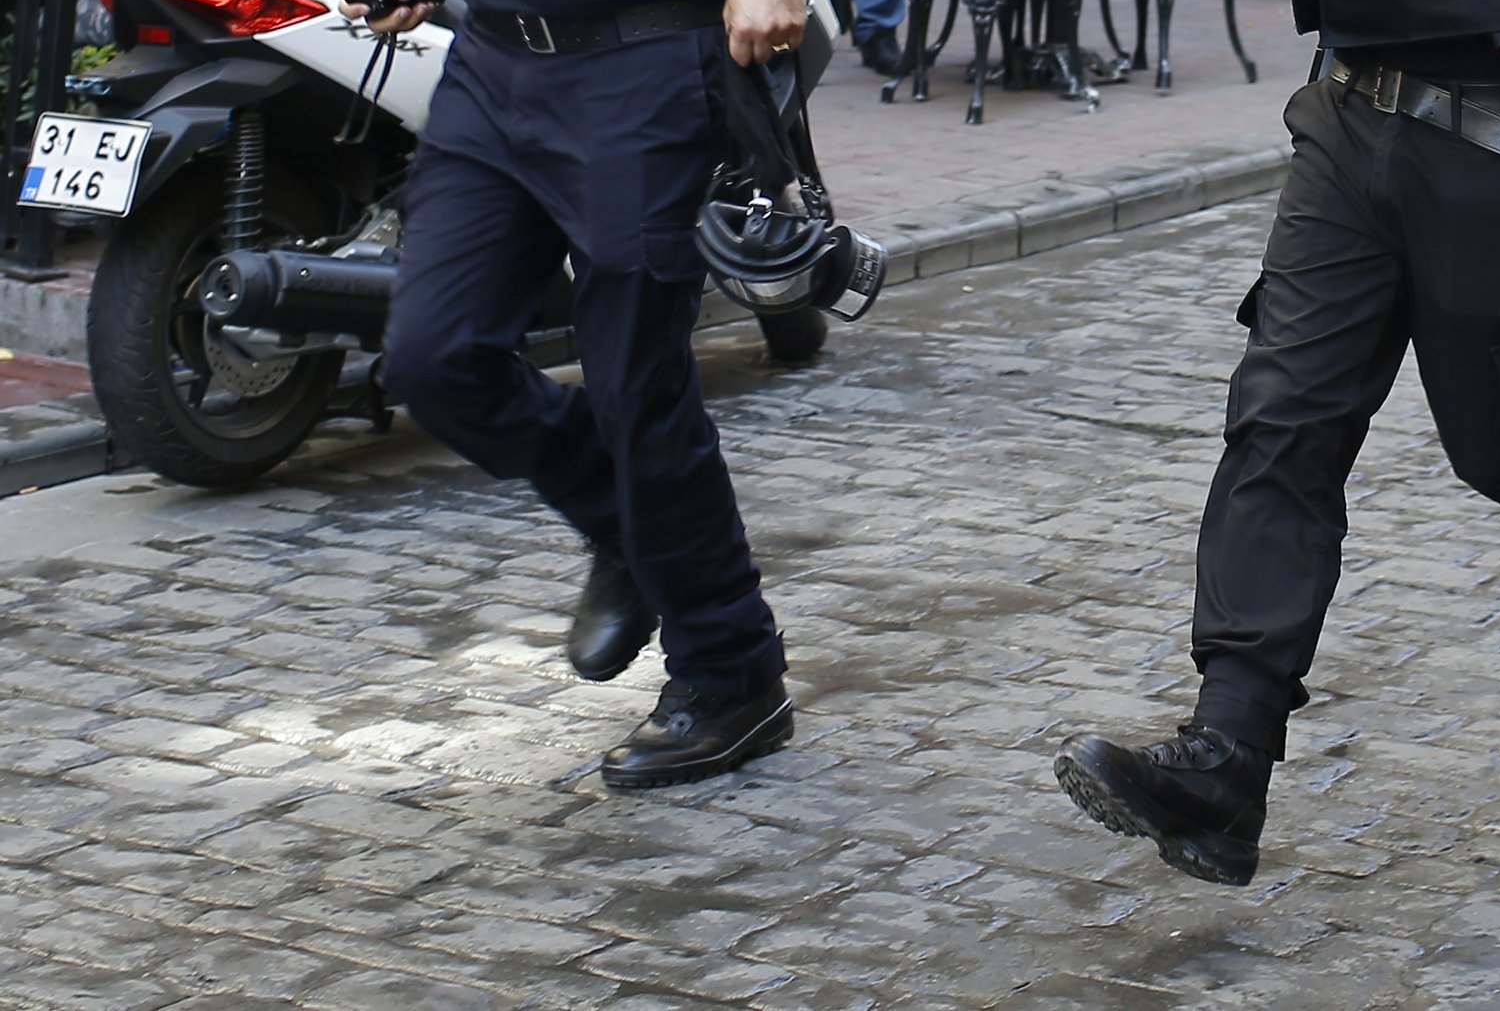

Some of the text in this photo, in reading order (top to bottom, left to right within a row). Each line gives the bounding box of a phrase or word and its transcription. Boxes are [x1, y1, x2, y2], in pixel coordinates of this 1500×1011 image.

[40, 124, 136, 163] 31 EJ
[50, 168, 104, 201] 146
